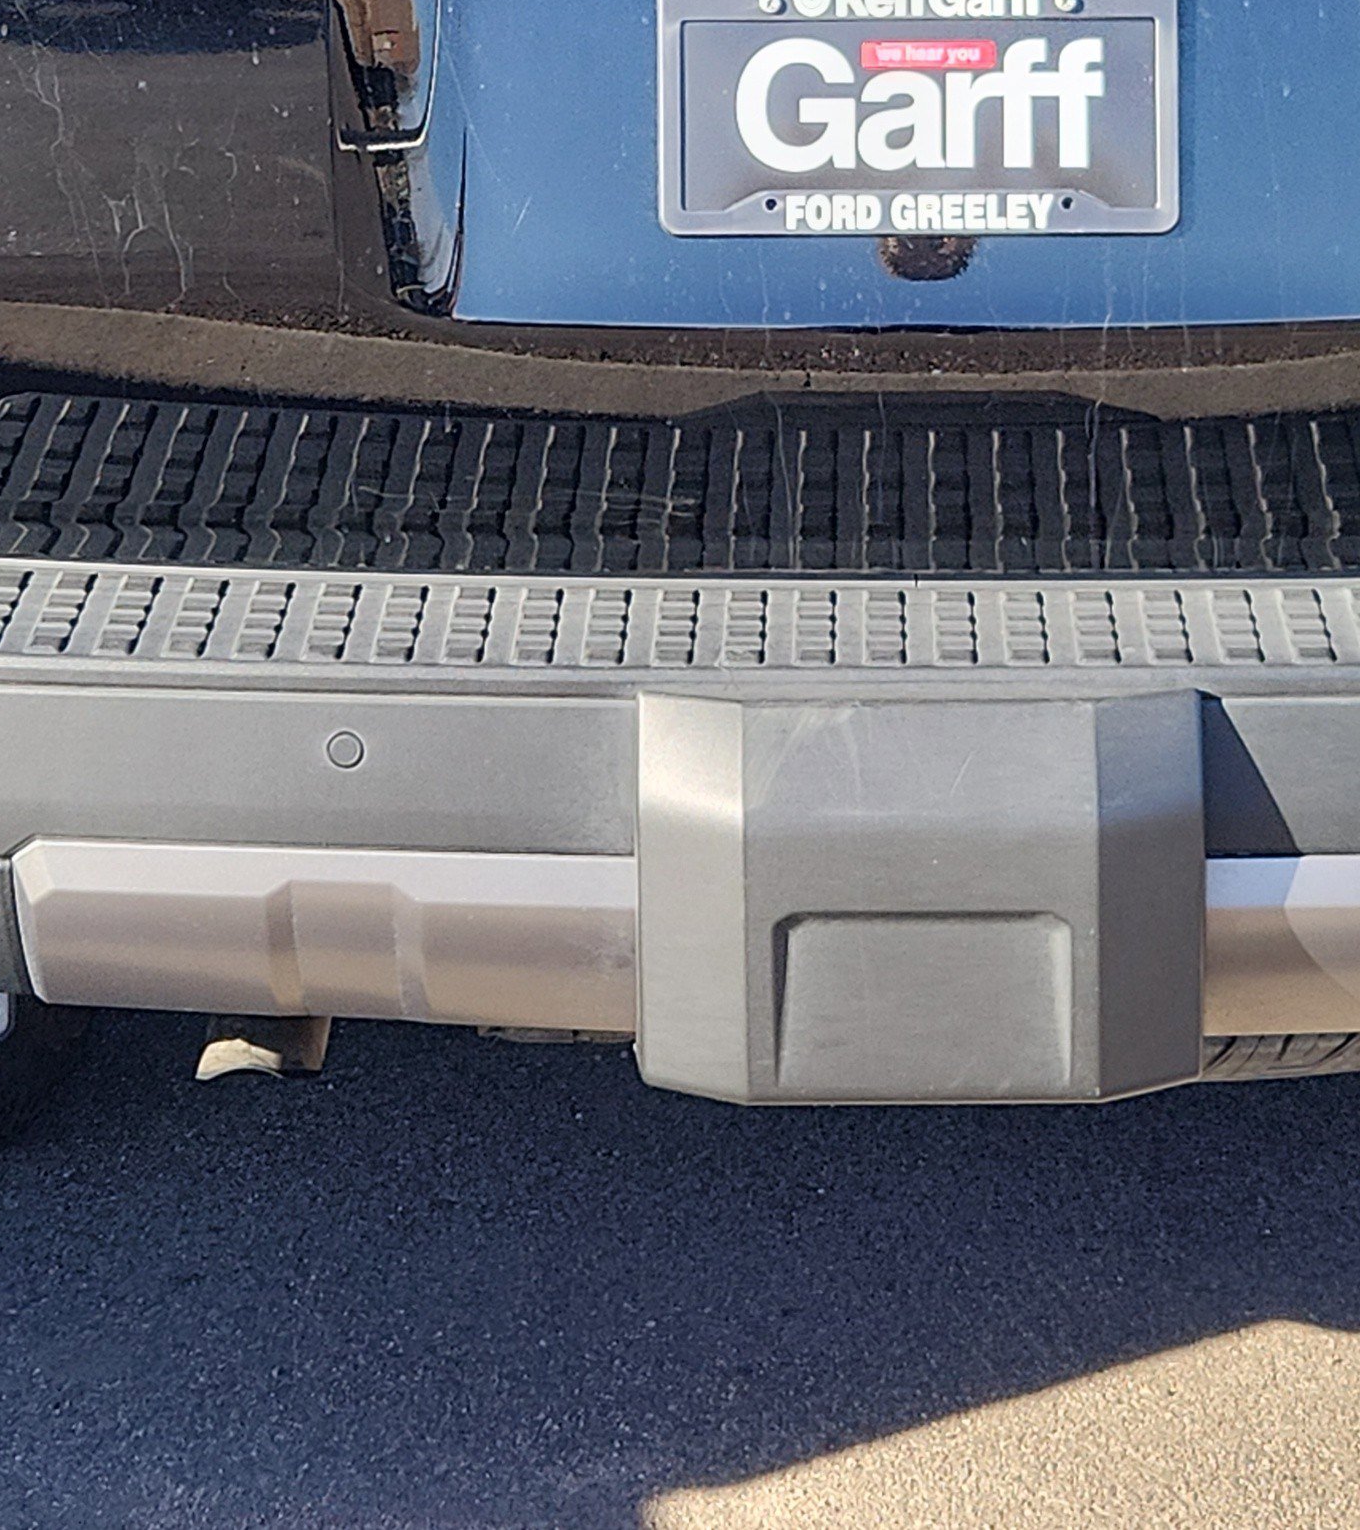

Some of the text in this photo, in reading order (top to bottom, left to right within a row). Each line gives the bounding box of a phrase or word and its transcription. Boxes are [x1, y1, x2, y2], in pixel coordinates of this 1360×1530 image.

[946, 48, 980, 64] you
[735, 37, 1104, 174] Garff
[785, 194, 1053, 231] FORD GREELEY
